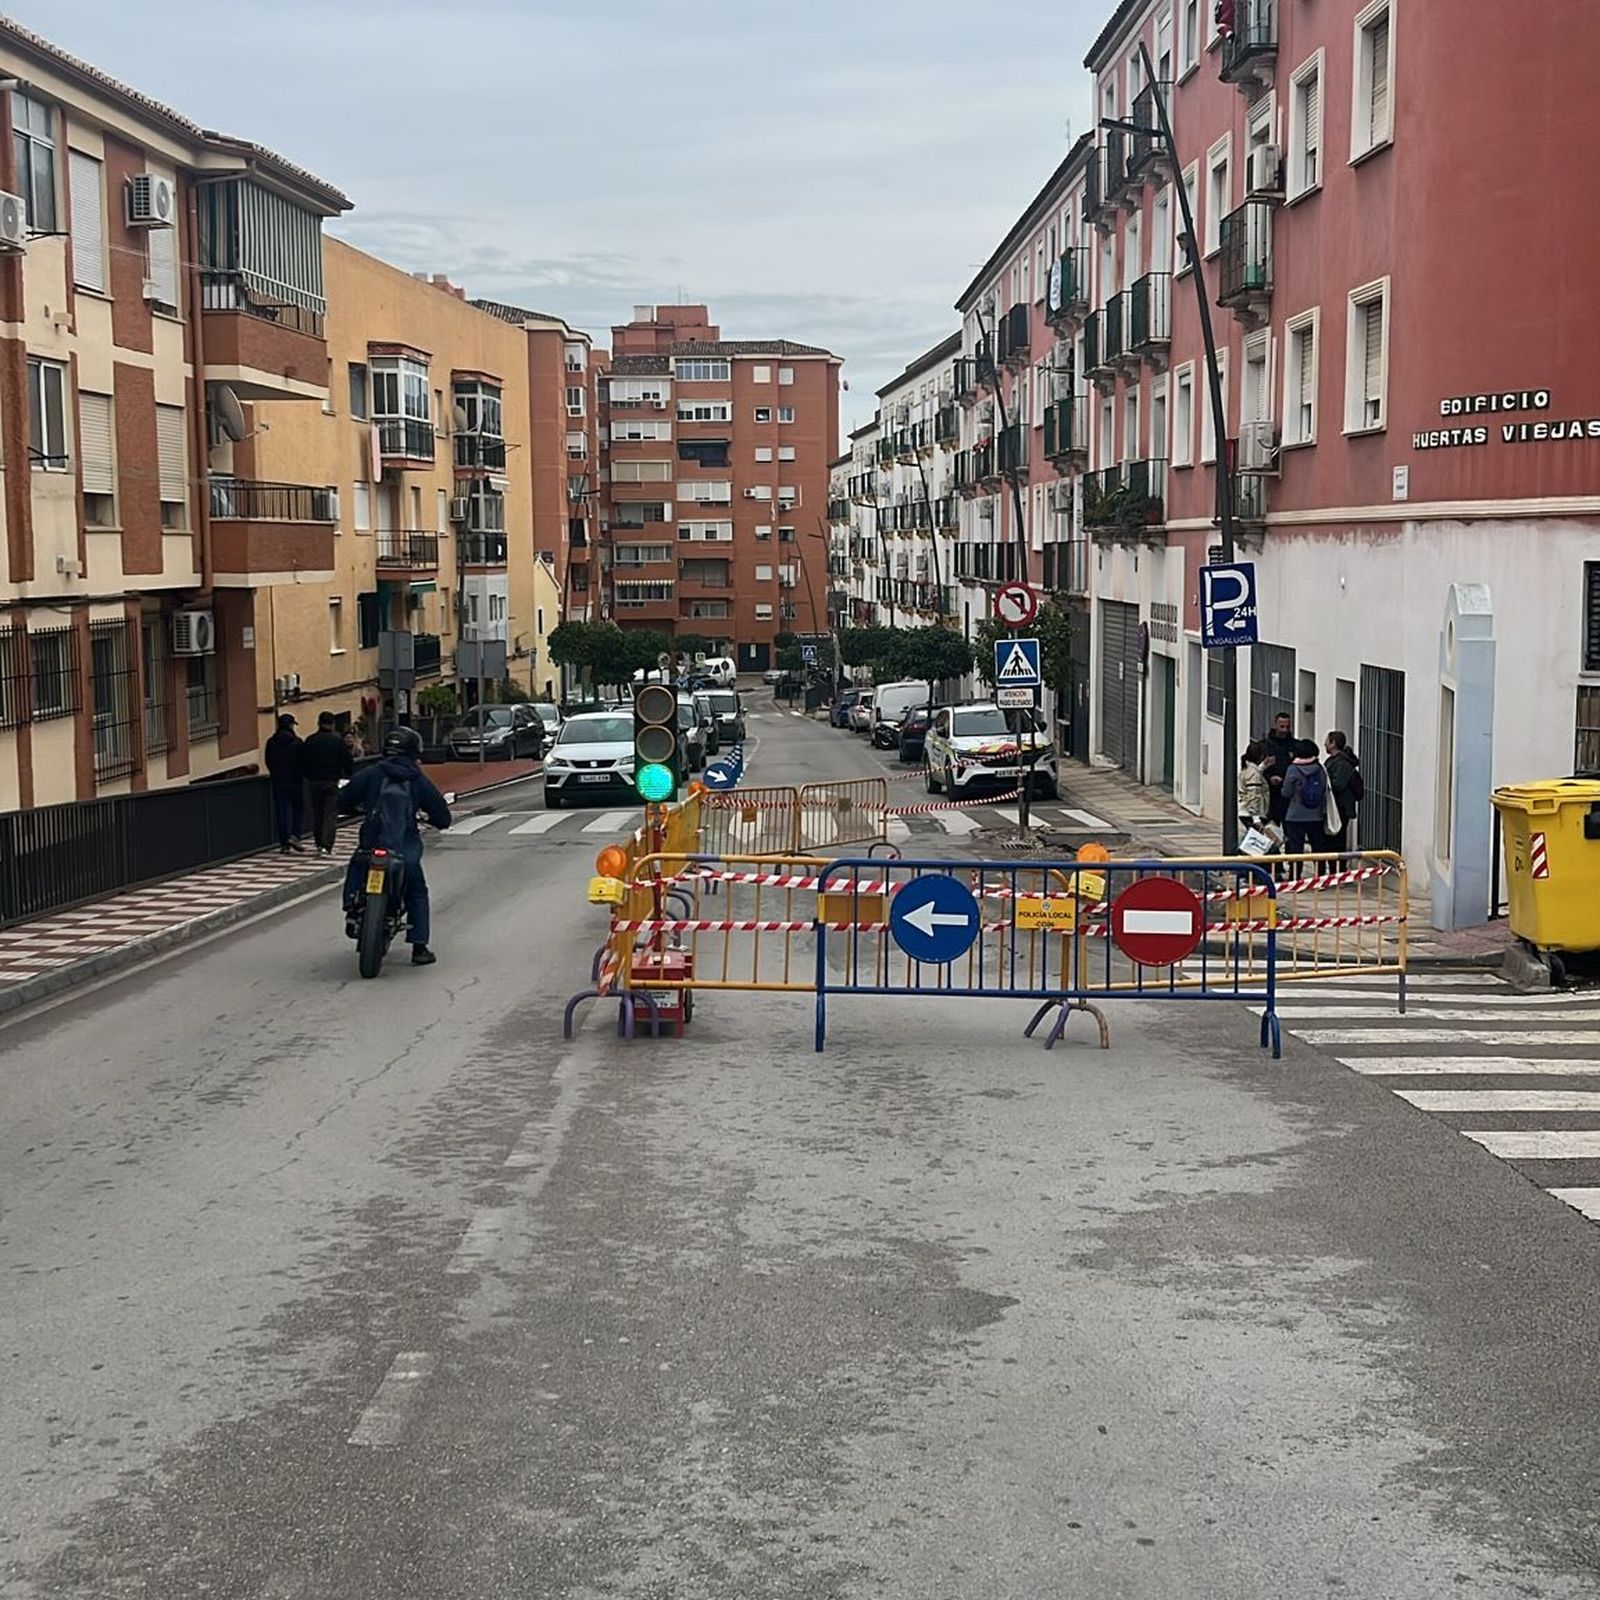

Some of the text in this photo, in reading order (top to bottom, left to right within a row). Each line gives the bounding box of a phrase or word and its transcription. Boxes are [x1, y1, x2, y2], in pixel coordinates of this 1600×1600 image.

[1440, 391, 1550, 416] EDIFICIO
[1412, 419, 1600, 449] HUERTAS VIEJAS
[1233, 606, 1257, 618] 24H
[1206, 634, 1254, 646] ANDALUCÍA
[1048, 911, 1072, 919] LOCAL
